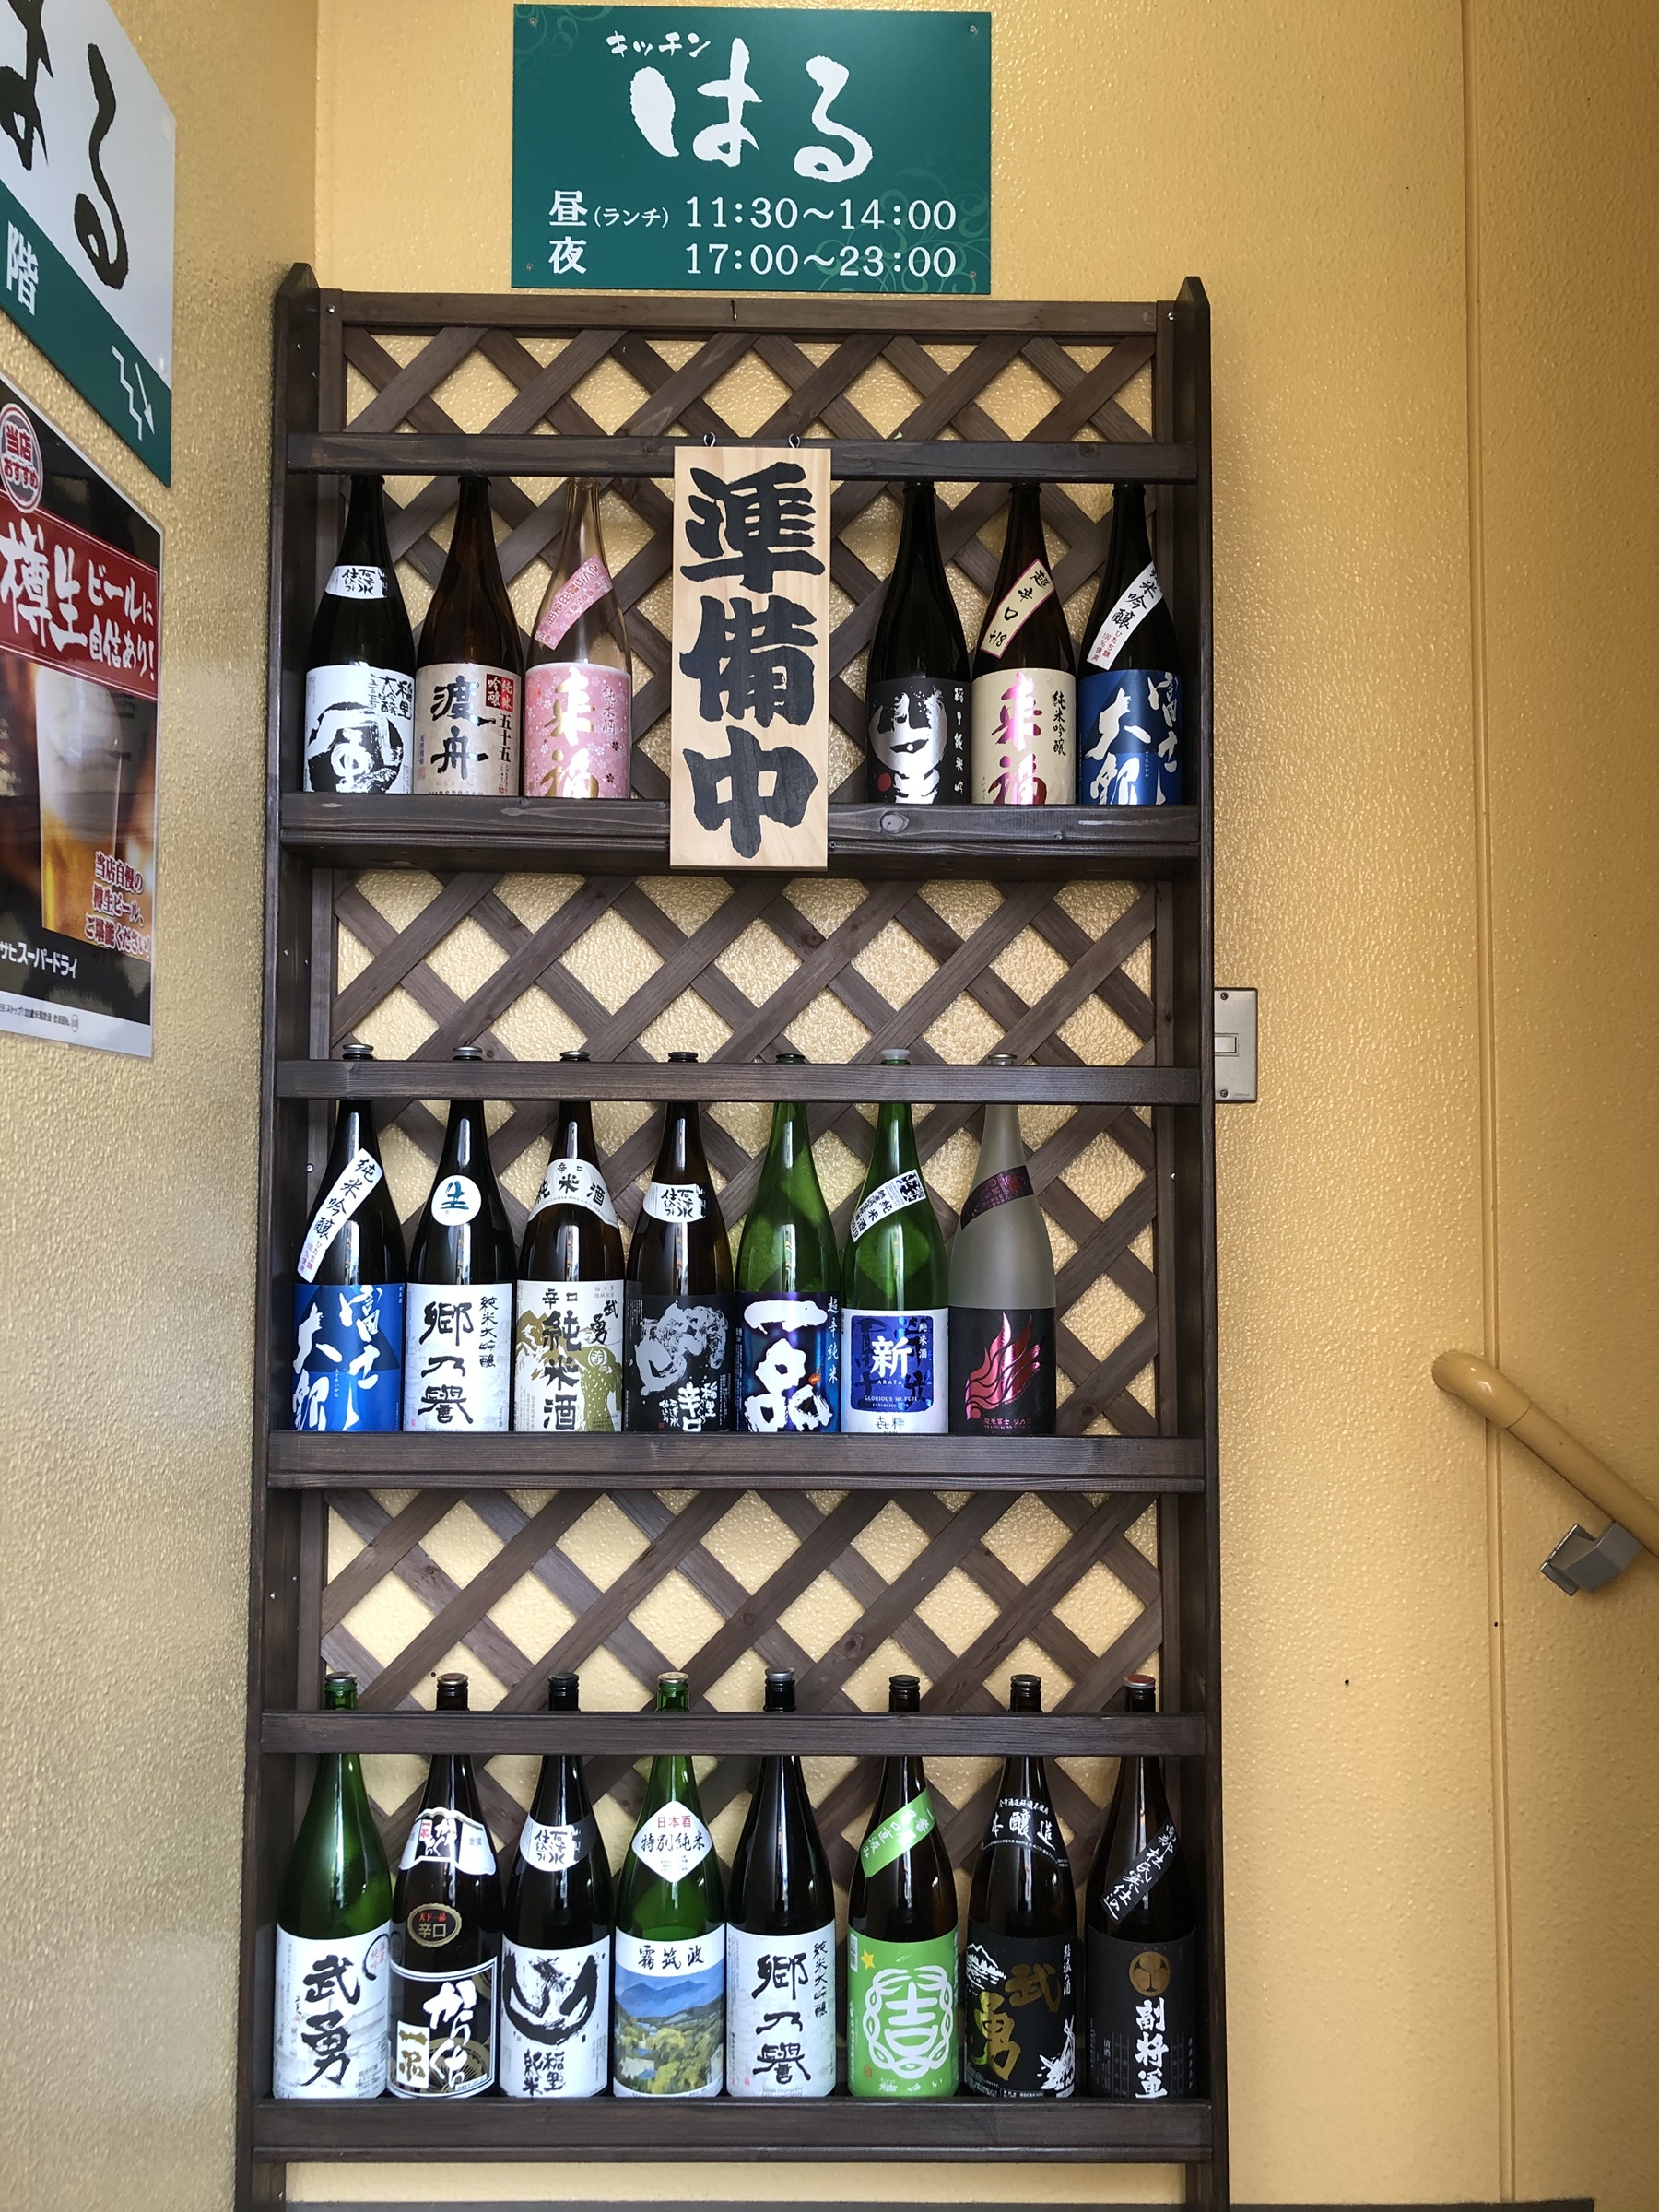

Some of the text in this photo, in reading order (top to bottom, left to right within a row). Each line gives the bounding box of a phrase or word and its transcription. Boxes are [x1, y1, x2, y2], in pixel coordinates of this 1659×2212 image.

[606, 30, 711, 58] キッチン
[629, 37, 873, 182] はる
[549, 236, 587, 275] 夜
[5, 422, 33, 463] 当店
[0, 518, 88, 652] 樽生
[88, 559, 154, 626] ビールに
[679, 462, 826, 859] 準備中
[430, 675, 496, 780] 渡舟
[602, 685, 617, 735] 純米酒
[1051, 690, 1067, 757] 純米吟醸
[498, 712, 513, 763] 五十五
[94, 851, 144, 894] 当店自慢の
[536, 1173, 606, 1208] 純米酒
[557, 1161, 584, 1174] 辛口
[313, 1158, 375, 1241] 純米吟醸
[441, 1181, 469, 1212] 生
[856, 1199, 893, 1232] 純米酒
[542, 1288, 579, 1311] 辛口
[589, 1300, 620, 1347] 武勇
[478, 1296, 500, 1369] 純米大吟醸
[826, 1295, 840, 1384] 超辛純米
[870, 1335, 912, 1378] 新
[918, 1322, 928, 1359] 純米酒
[541, 1310, 582, 1431] 純米酒
[743, 1300, 833, 1433] 一品
[677, 1382, 703, 1433] 辛口
[864, 1394, 893, 1403] GLORIOUS
[640, 1832, 706, 1853] 特別純米
[657, 1815, 692, 1829] 日本酒
[991, 1807, 1057, 1851] 本醸造
[418, 1923, 448, 1939] 辛口
[637, 1944, 705, 1971] 霧筑波
[812, 1939, 829, 2018] 純米大吟醸
[301, 1954, 361, 2087] 武勇
[973, 1963, 1061, 2082] 武勇
[1134, 1996, 1170, 2099] 副将軍
